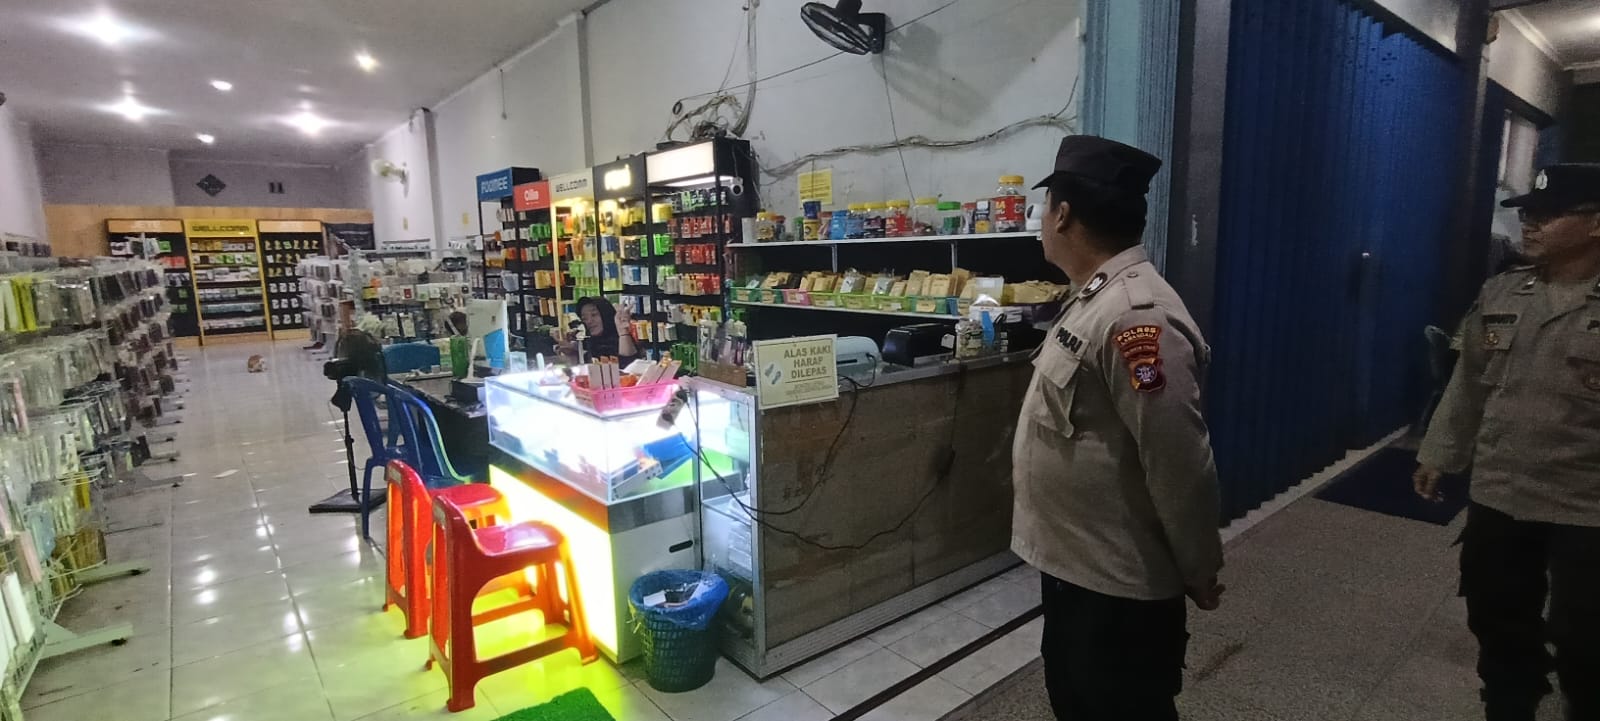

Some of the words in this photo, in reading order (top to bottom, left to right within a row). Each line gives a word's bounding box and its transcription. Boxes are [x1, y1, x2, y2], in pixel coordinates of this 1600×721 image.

[1056, 326, 1083, 354] POLRI
[1117, 327, 1157, 341] POLRES
[784, 347, 807, 359] ALAS
[810, 345, 831, 355] KAKI
[793, 356, 824, 368] HARAP
[791, 366, 827, 379] DILEPAS
